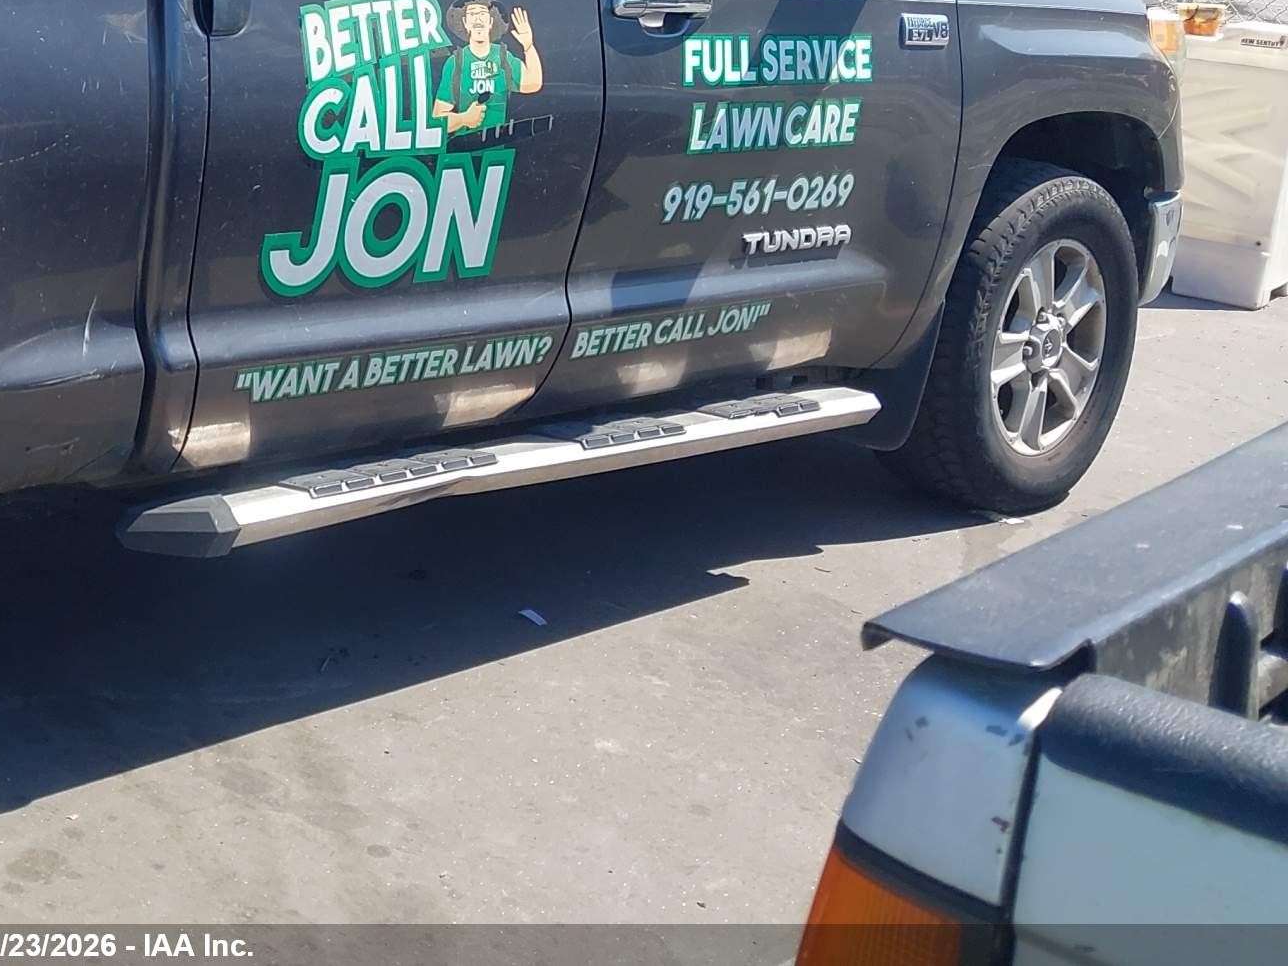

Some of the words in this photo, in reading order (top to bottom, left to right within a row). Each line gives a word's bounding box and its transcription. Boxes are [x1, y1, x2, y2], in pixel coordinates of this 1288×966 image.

[933, 22, 948, 39] V8
[684, 38, 757, 83] FULL
[762, 38, 872, 83] SERVICE
[303, 55, 442, 154] CALL
[469, 79, 495, 94] JON
[690, 106, 783, 151] LAWN
[785, 103, 860, 145] CARE
[662, 173, 855, 223] 919-561-0269
[269, 165, 505, 286] JON
[743, 224, 852, 255] TUNDRA
[236, 362, 340, 402] "WANT
[339, 361, 360, 390] A
[363, 348, 459, 387] BETTER
[460, 336, 553, 374] LAWN?
[571, 322, 652, 359] BETTER
[653, 313, 705, 345] CALL
